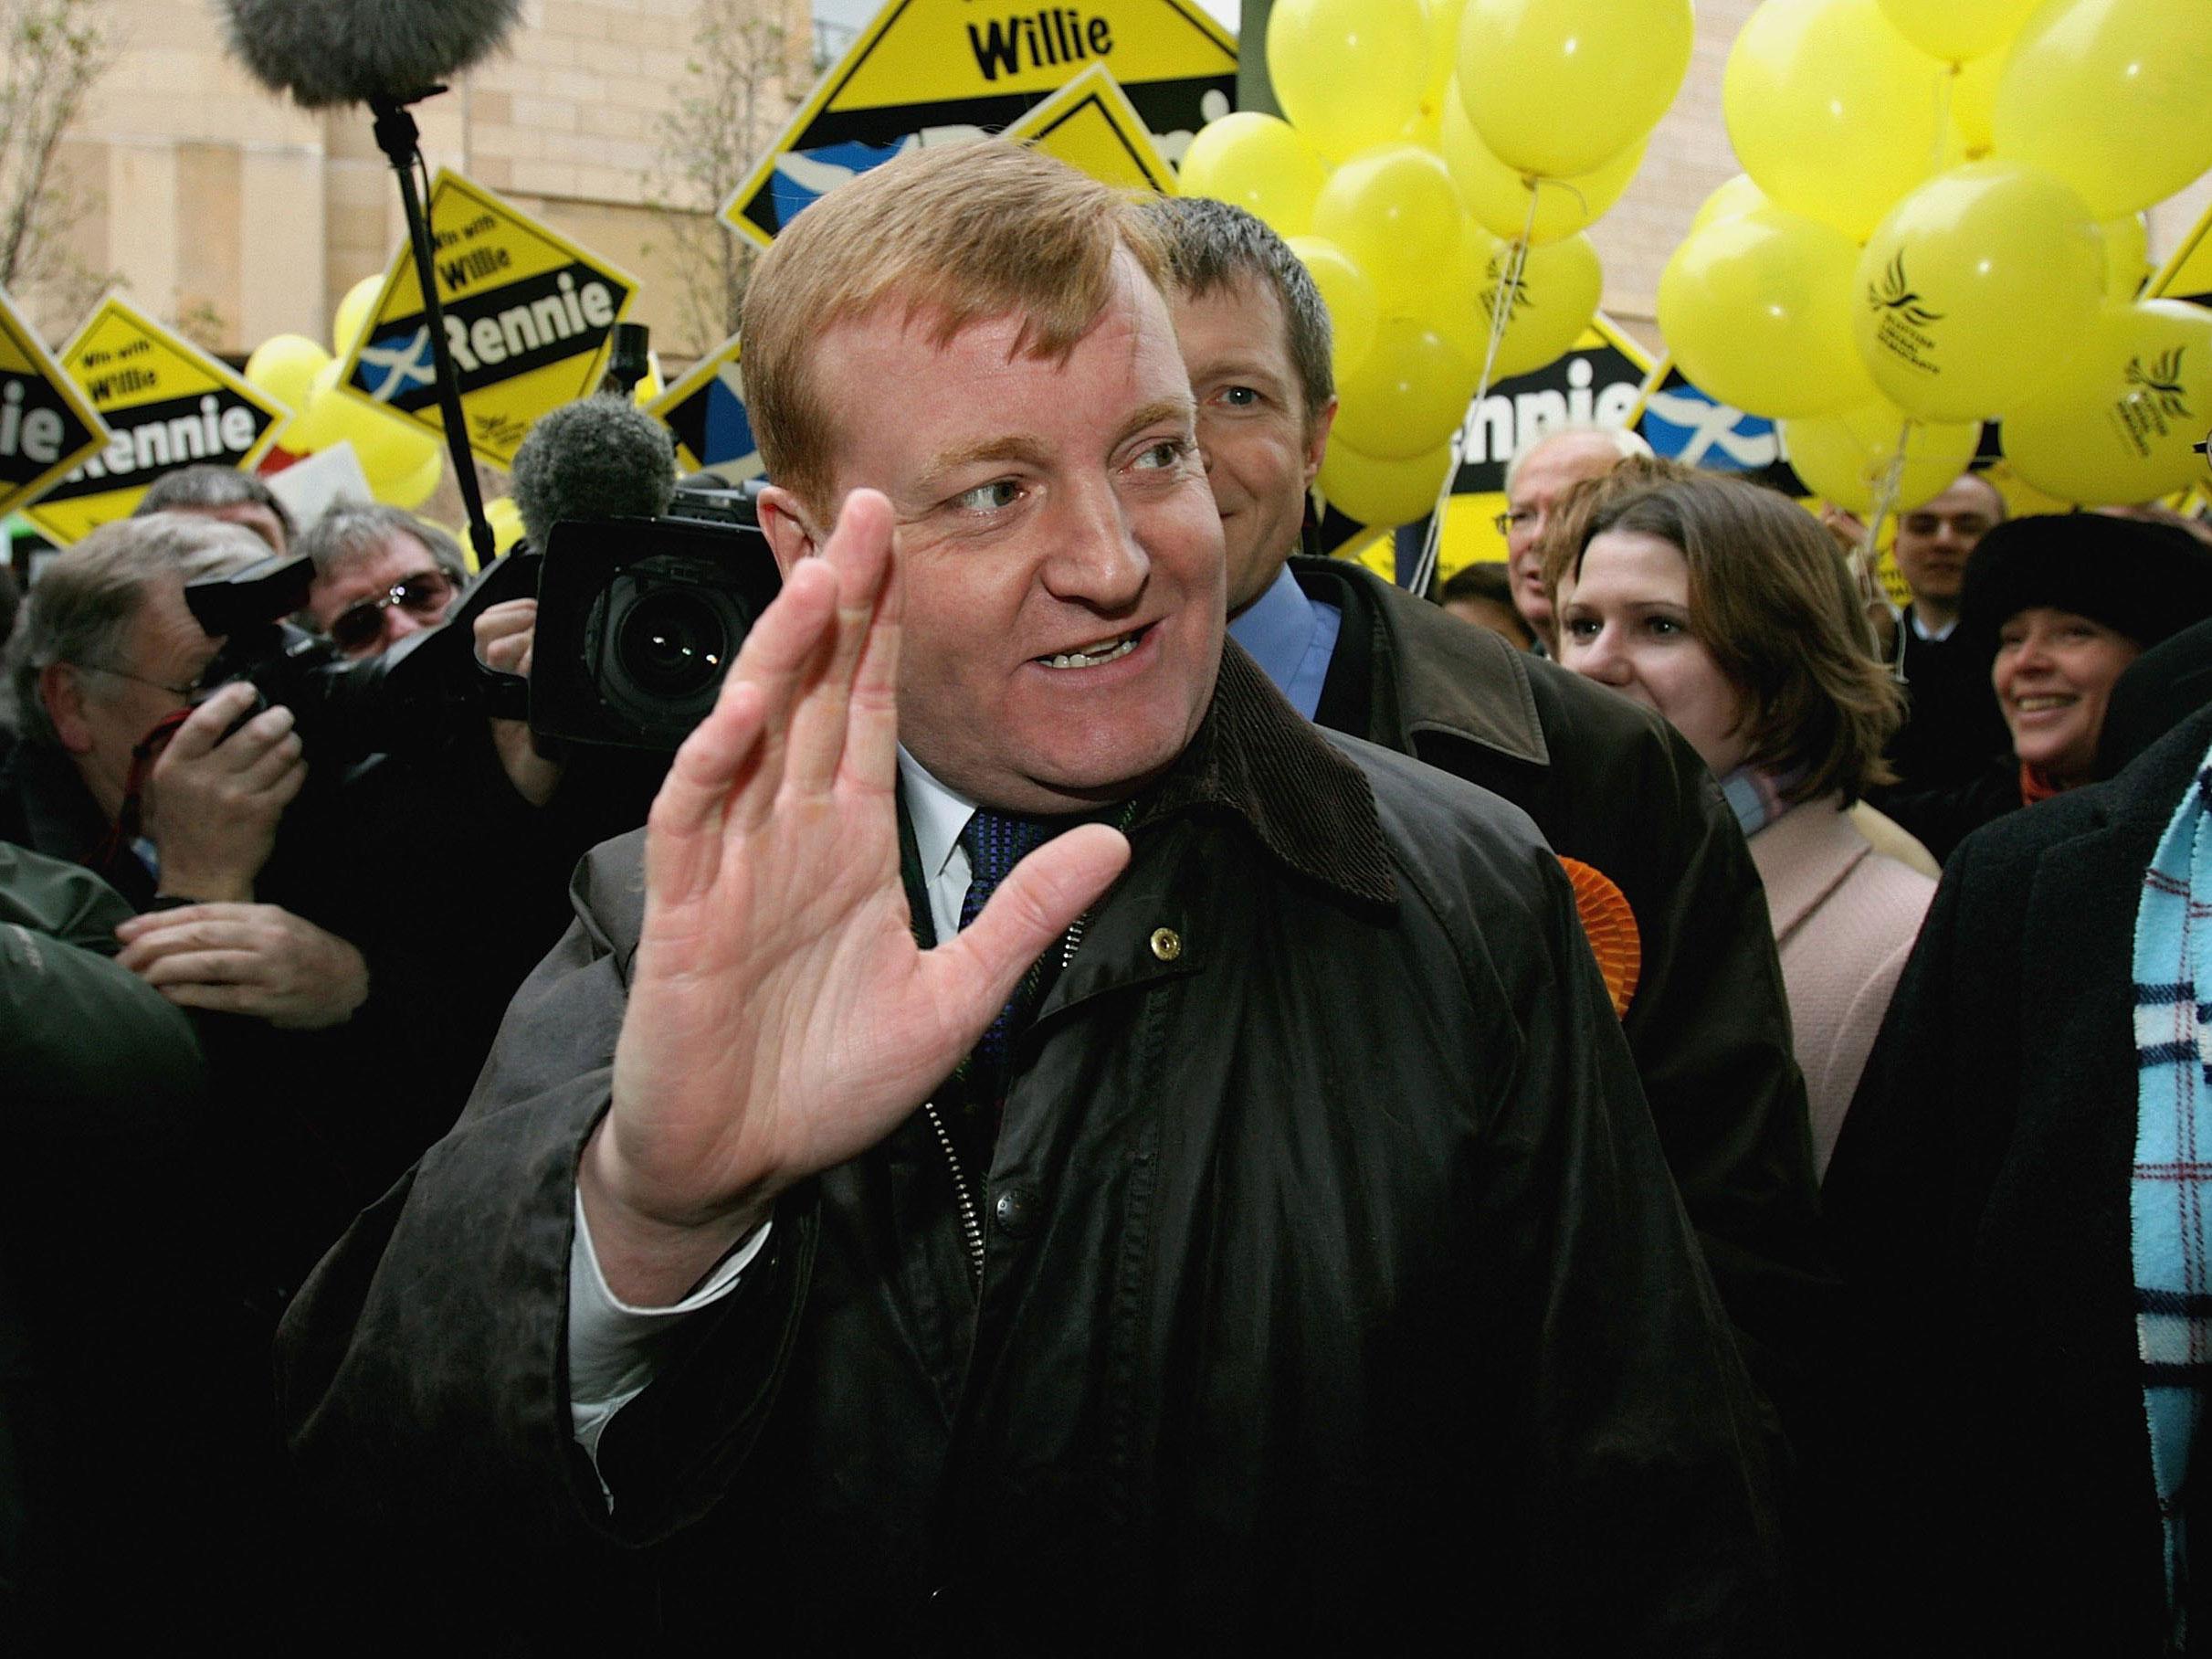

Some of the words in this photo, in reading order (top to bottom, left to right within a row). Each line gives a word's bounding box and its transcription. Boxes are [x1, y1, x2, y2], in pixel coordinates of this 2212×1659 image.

[967, 8, 1114, 80] Willie
[438, 246, 511, 291] Willie
[89, 367, 156, 403] Willie
